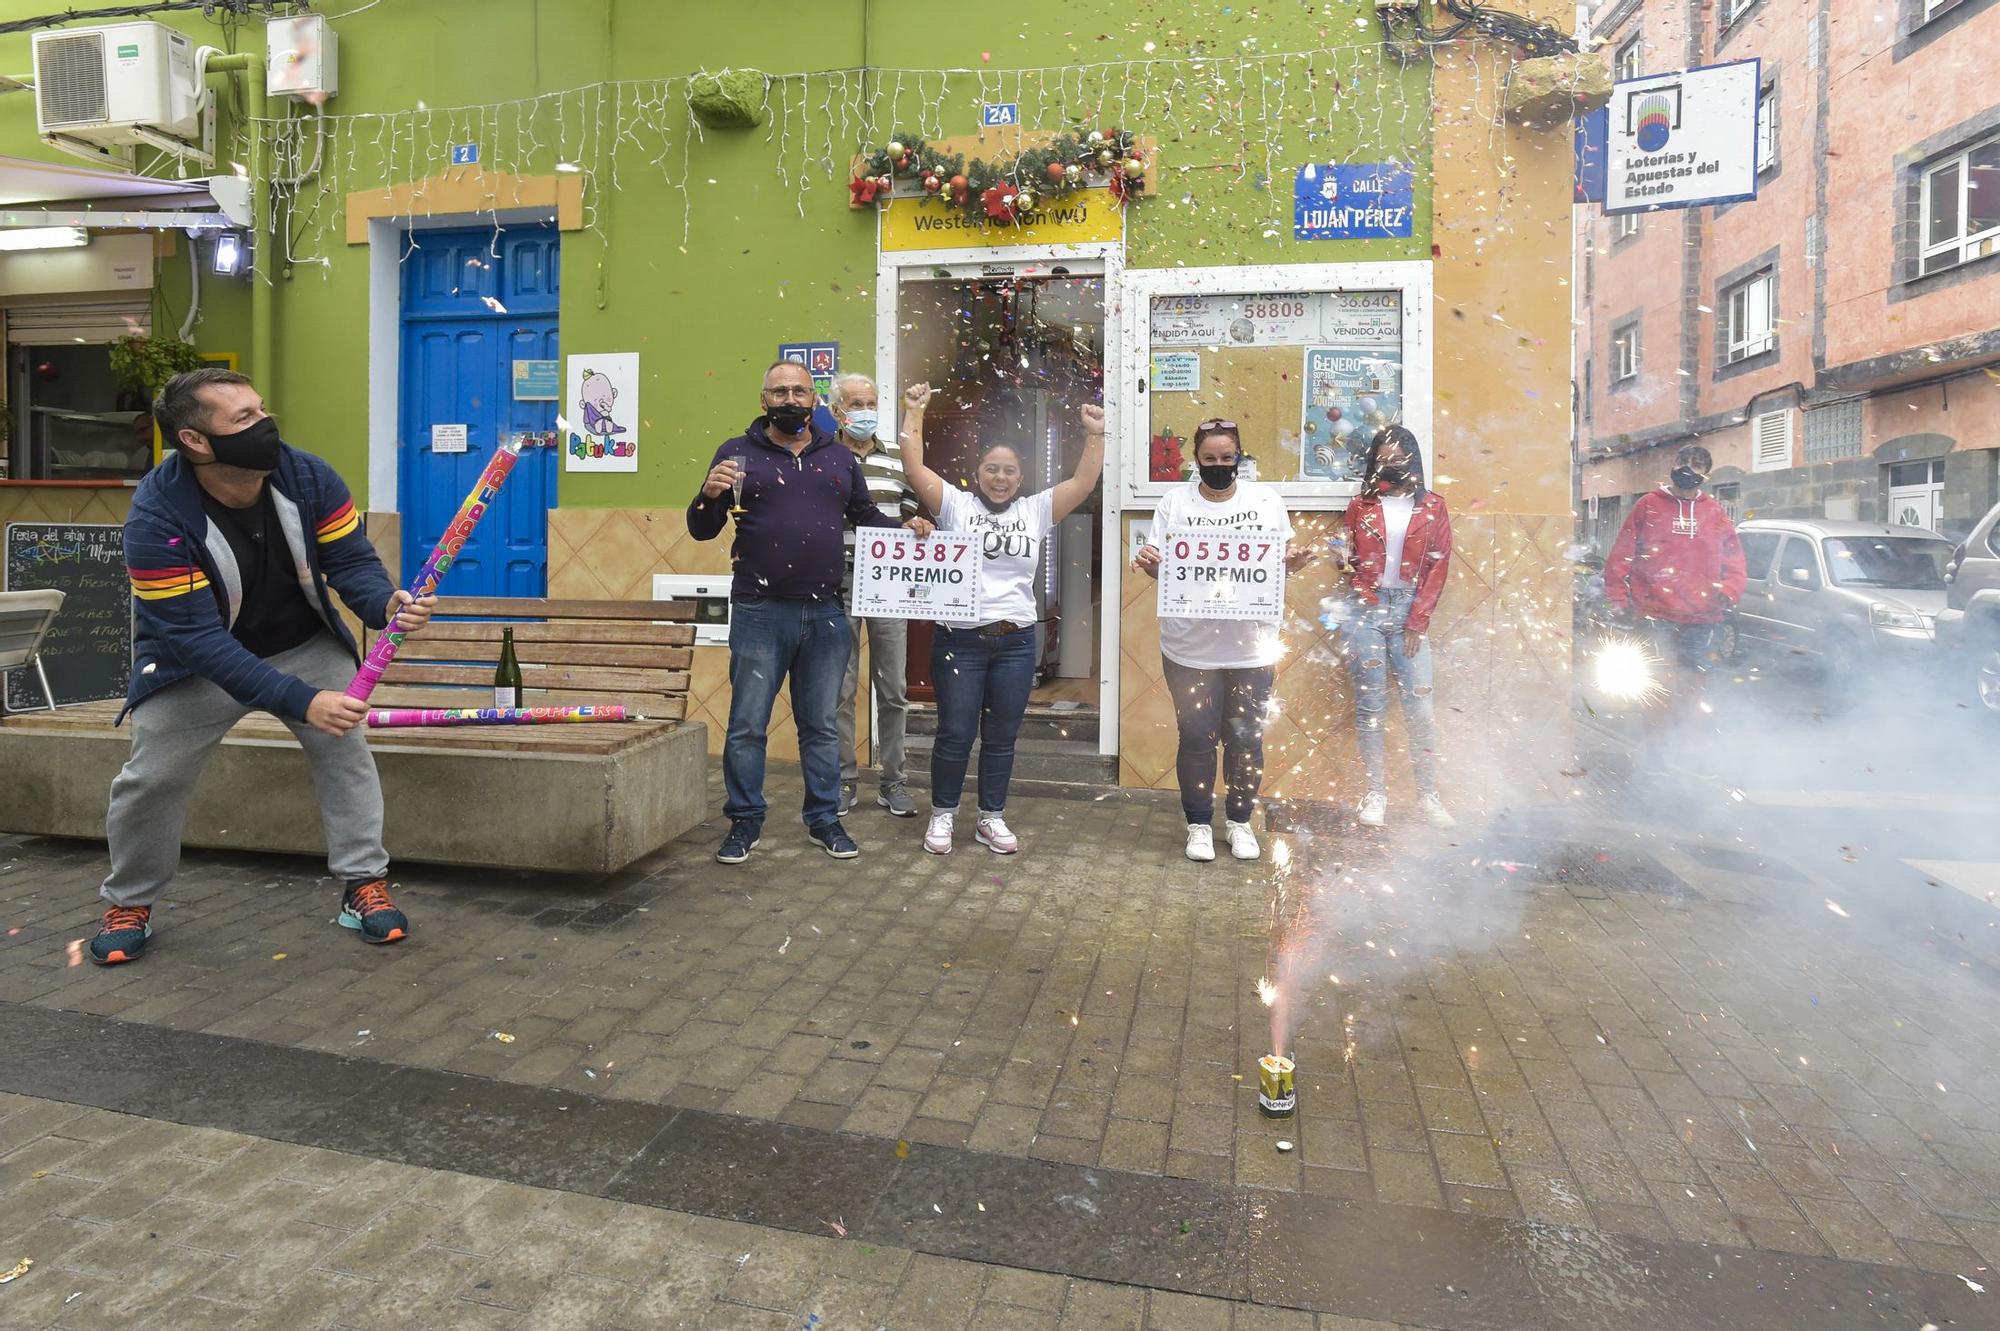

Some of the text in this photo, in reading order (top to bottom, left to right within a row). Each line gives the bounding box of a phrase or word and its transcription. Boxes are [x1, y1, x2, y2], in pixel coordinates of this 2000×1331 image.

[989, 106, 1012, 124] 2A
[460, 147, 470, 162] 2
[1625, 151, 1697, 170] Loterías y
[1624, 160, 1720, 185] Apuestas del
[1352, 179, 1385, 193] CALLE
[1624, 181, 1675, 198] Estado
[1304, 205, 1403, 229] LUJÁN PÉREZ
[1244, 302, 1304, 318] 58808
[1151, 327, 1215, 338] ENDIDO AQUÍ
[1333, 327, 1401, 336] VENDIDO AQU
[1313, 354, 1361, 372] 6 ENERO
[1187, 510, 1259, 528] VENDIDO
[42, 528, 58, 541] del
[110, 531, 122, 544] MA
[871, 540, 968, 563] 05587
[1174, 540, 1271, 563] 05587
[889, 566, 964, 585] PREMIO
[1194, 566, 1268, 583] PREMIO
